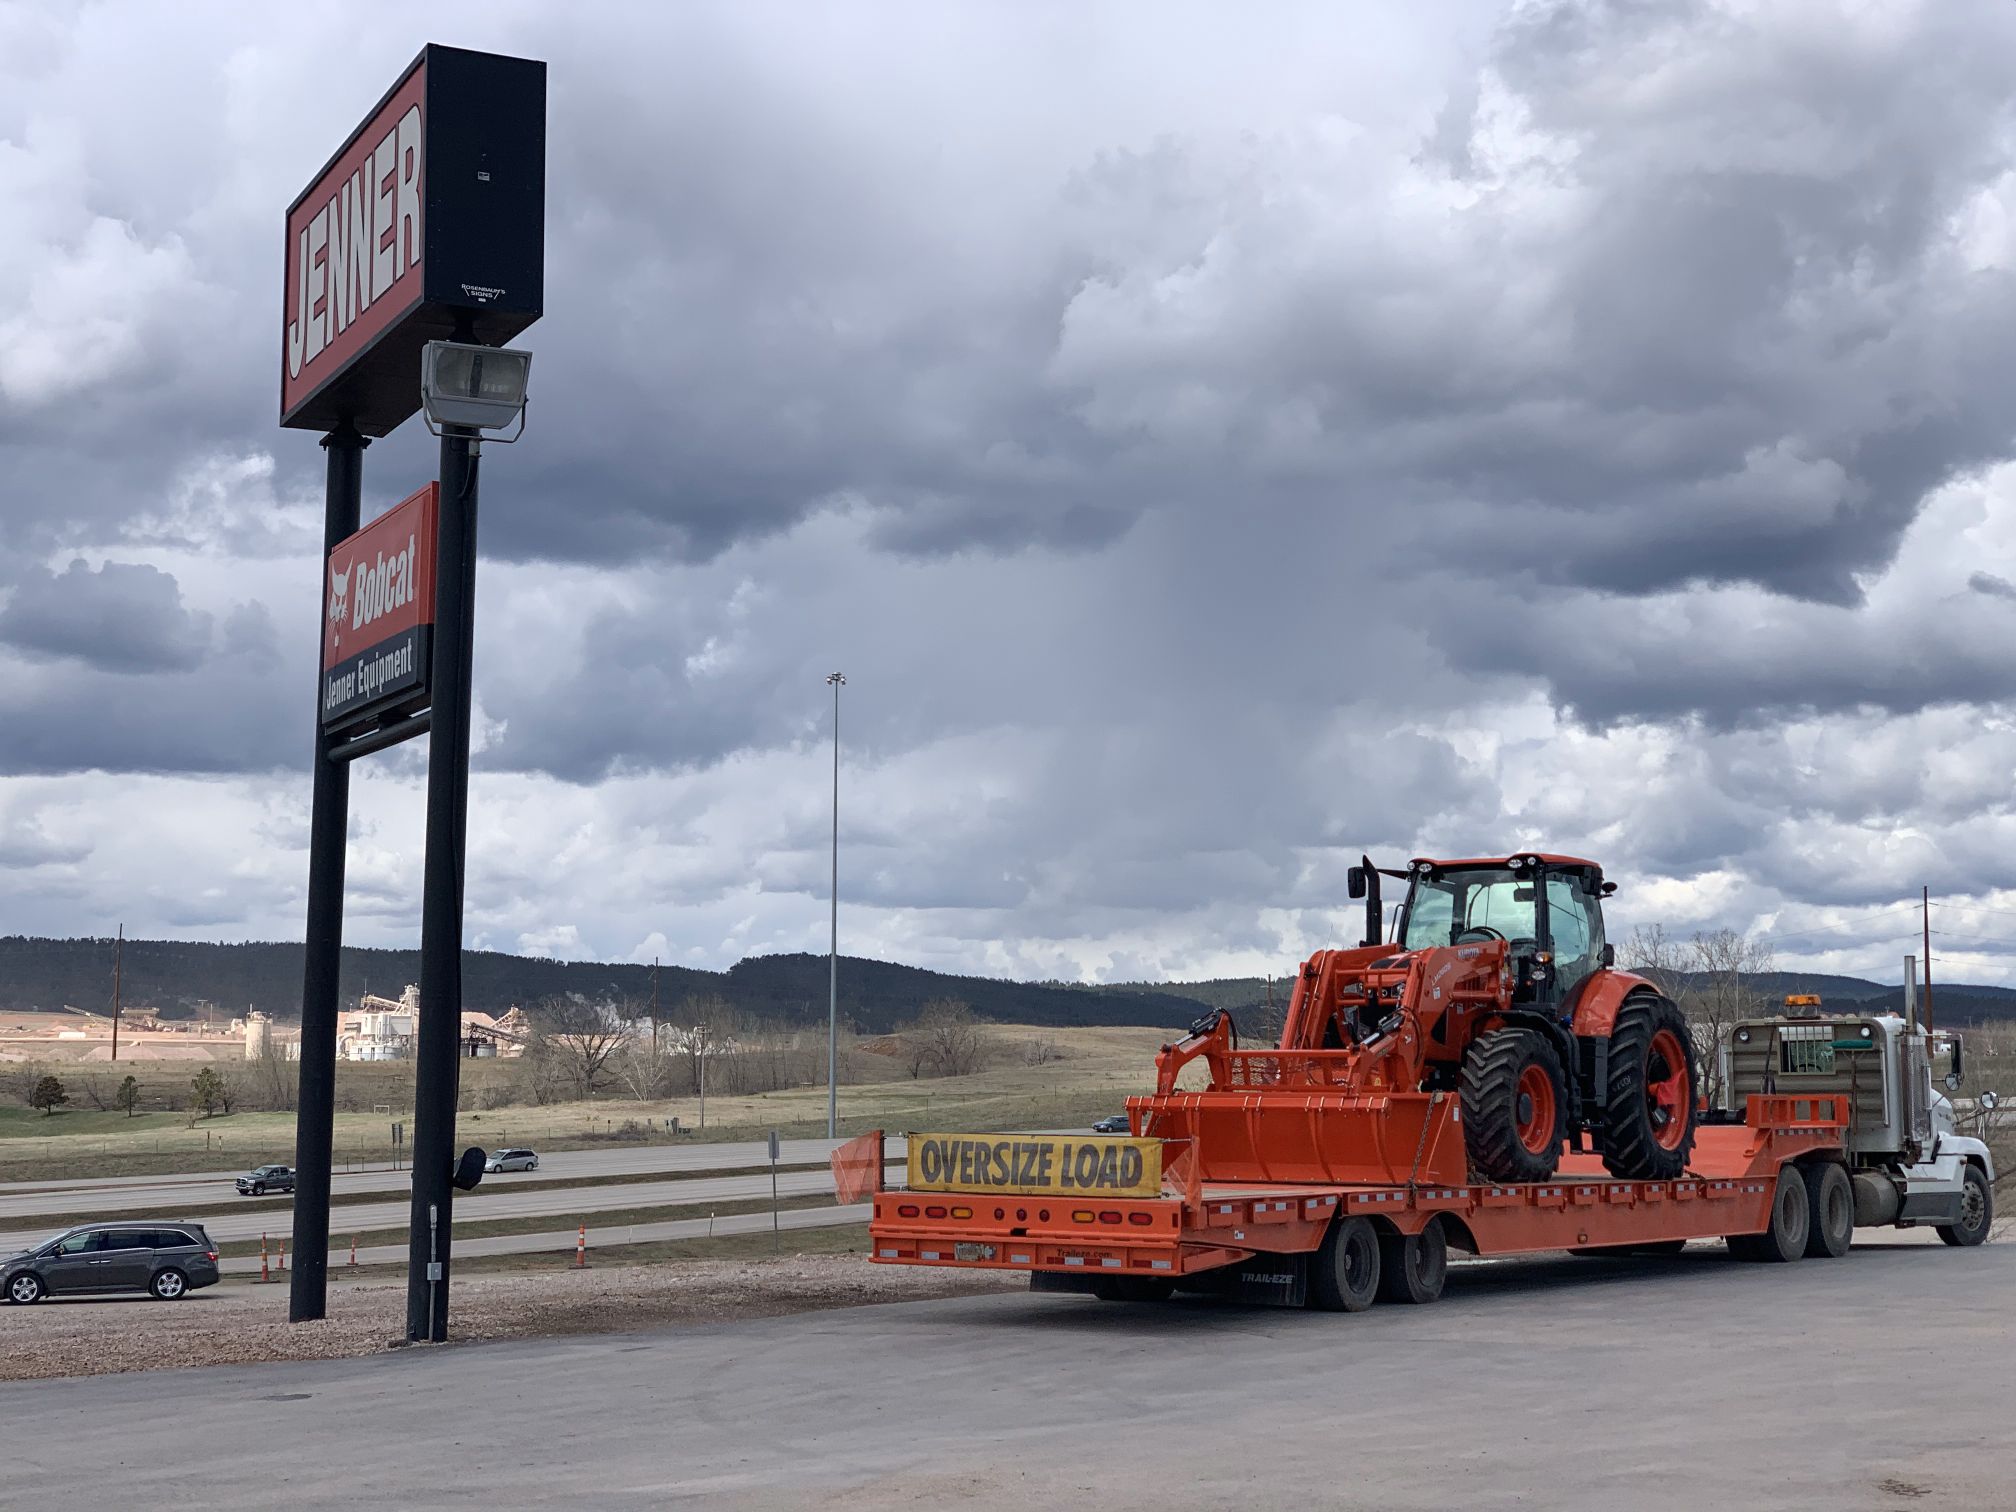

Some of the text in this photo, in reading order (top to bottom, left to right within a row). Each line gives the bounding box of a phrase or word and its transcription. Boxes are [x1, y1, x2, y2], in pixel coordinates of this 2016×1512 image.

[288, 102, 423, 381] JENNER
[470, 290, 493, 298] SIGNS
[352, 533, 416, 631] Bobcat
[326, 637, 412, 710] Jenner Equipment
[920, 1138, 1144, 1189] OVERSIZE LOAD
[1241, 1272, 1294, 1284] TRAIL-EZE
